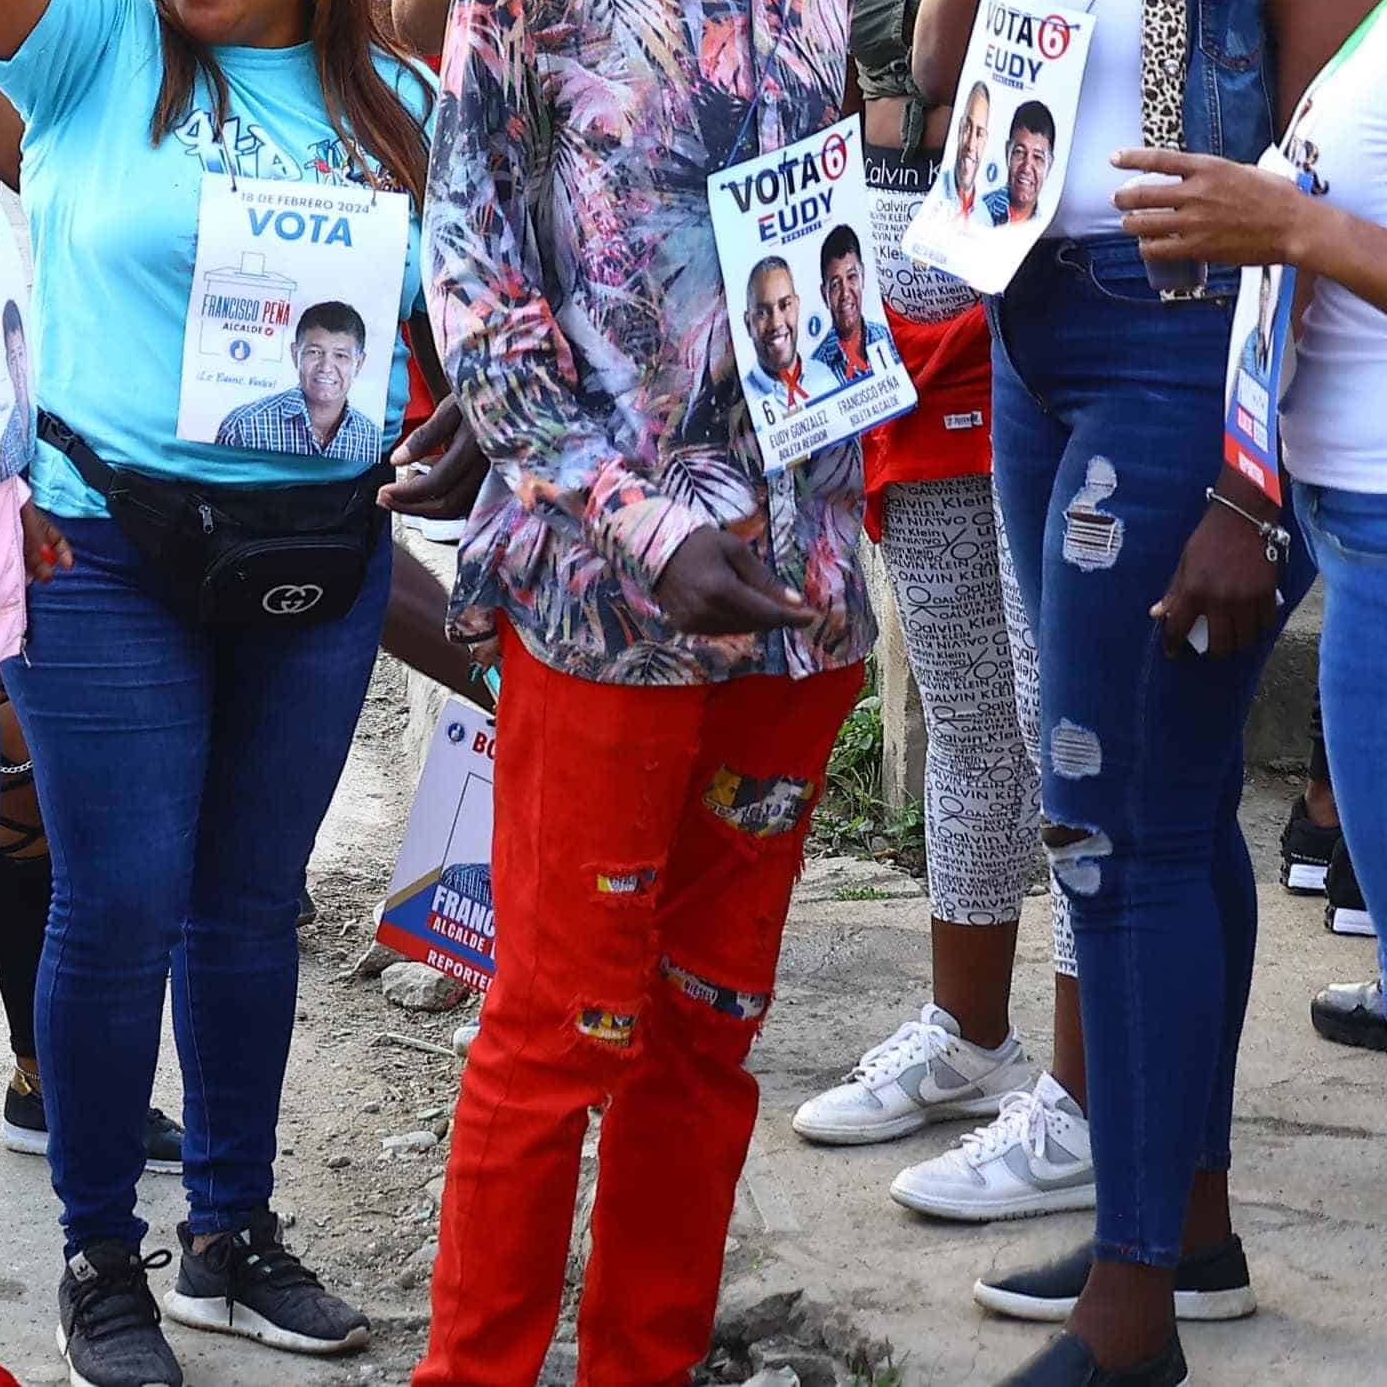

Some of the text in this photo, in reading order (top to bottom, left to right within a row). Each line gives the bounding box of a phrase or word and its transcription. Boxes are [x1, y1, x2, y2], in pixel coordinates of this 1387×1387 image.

[985, 0, 1033, 49] VOTA
[984, 44, 1044, 83] EUDY
[727, 152, 821, 214] VOTA
[240, 191, 370, 214] 18 DE FEBRERO 2024
[758, 186, 833, 242] EUDY
[248, 208, 353, 247] VOTA
[201, 293, 291, 326] FRANCISCO PEÑA
[222, 322, 263, 334] ALCALDE
[876, 345, 888, 371] 1
[762, 399, 777, 426] 6
[837, 374, 901, 415] FRANCISCO PEÑA
[769, 428, 791, 450] EUDY
[431, 916, 485, 953] ALCALDE
